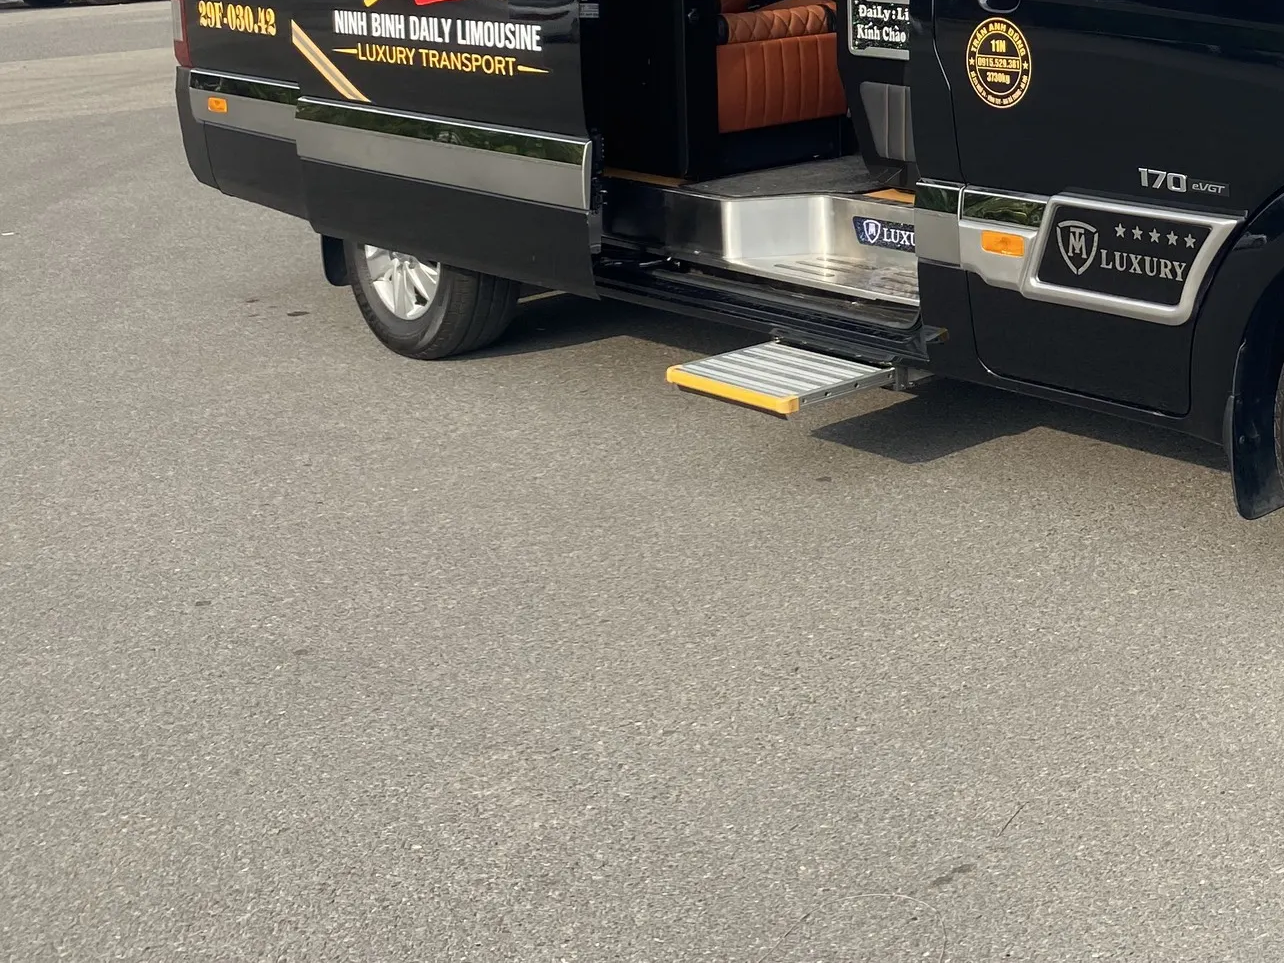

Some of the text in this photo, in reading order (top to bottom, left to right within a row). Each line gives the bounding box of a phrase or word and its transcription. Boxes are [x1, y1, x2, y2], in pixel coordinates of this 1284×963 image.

[334, 9, 542, 52] NINH BINH DAILY LIMOUSINE
[856, 21, 880, 40] Kính
[988, 22, 1007, 32] ANH
[357, 42, 516, 77] LUXURY TRANSPORT
[1138, 167, 1226, 194] 170 eVGT
[1100, 249, 1187, 282] LUXURY
